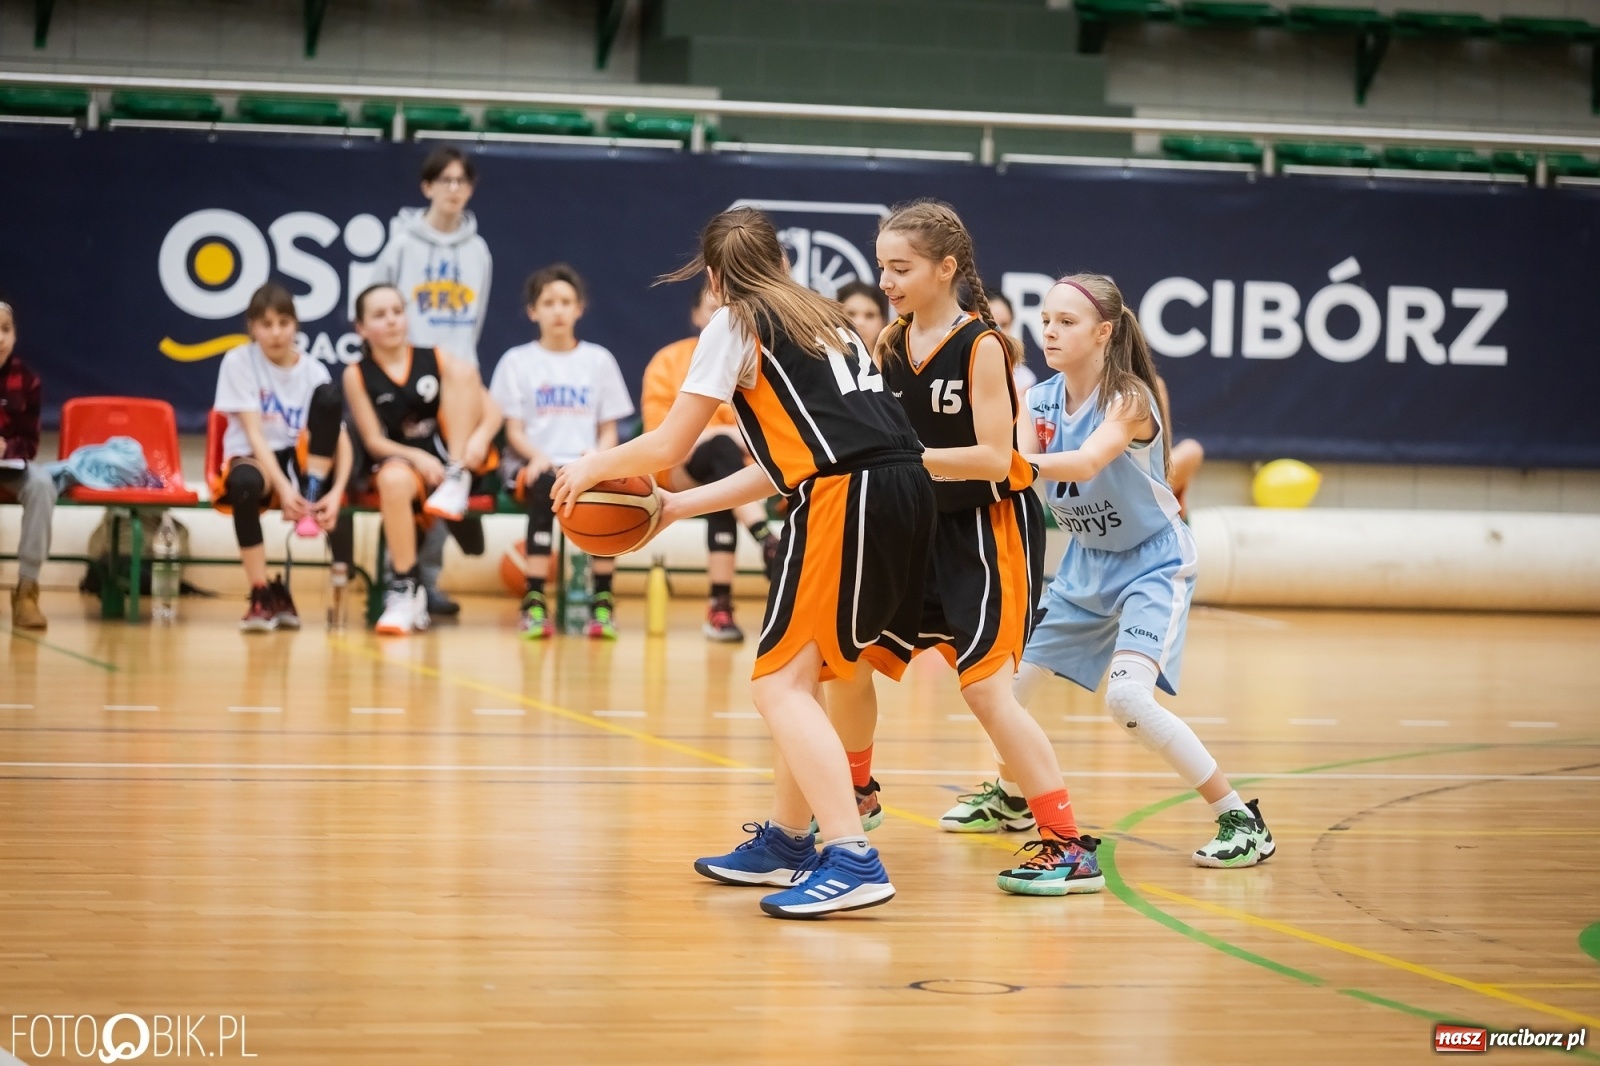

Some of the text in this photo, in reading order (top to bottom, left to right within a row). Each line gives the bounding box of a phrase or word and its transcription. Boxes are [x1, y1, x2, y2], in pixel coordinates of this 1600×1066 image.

[1001, 256, 1508, 366] RCIBÓRZ
[815, 326, 884, 396] 12
[415, 374, 439, 403] 9
[929, 378, 963, 414] 15
[1058, 511, 1122, 537] yprys
[1072, 500, 1114, 516] WILLA
